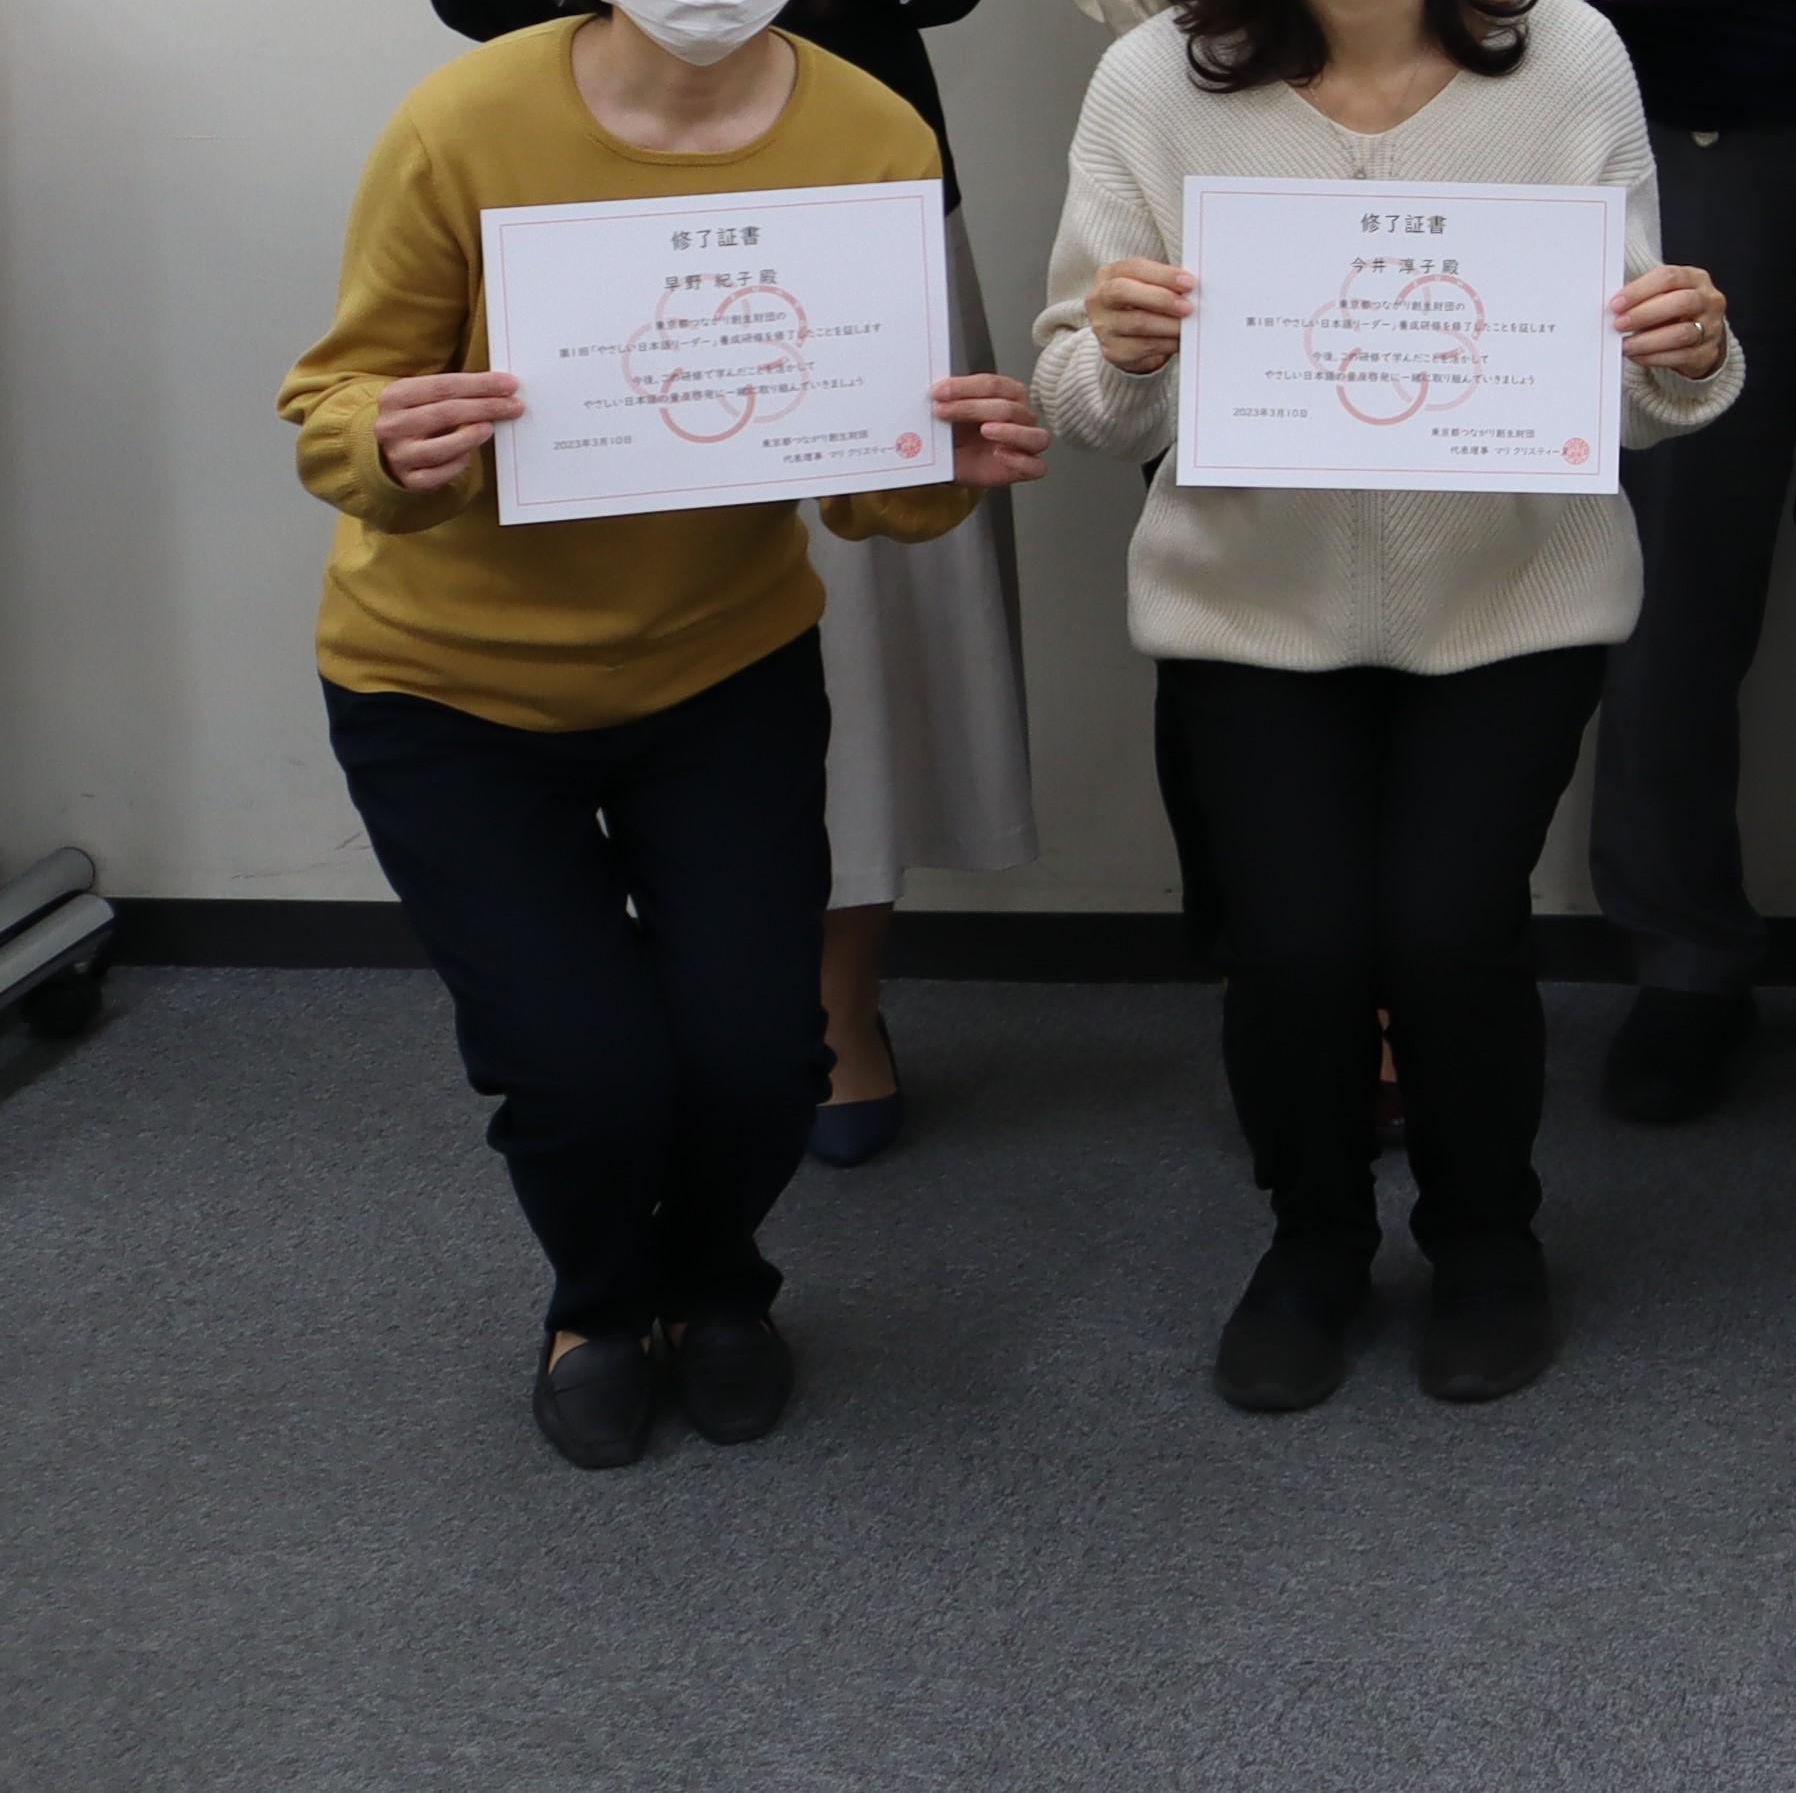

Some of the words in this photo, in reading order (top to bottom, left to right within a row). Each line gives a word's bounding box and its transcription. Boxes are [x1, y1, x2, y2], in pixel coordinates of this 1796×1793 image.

[1361, 214, 1446, 234] 修了証書
[671, 226, 759, 250] 修了証書
[1352, 257, 1386, 273] 今井
[665, 275, 702, 291] 早野
[1340, 298, 1465, 311] 東京都つながり創生財団の
[1233, 408, 1307, 418] 2023年3月10日
[1432, 428, 1534, 438] 東京都つながり創生財団
[1451, 446, 1488, 455] 代表理事
